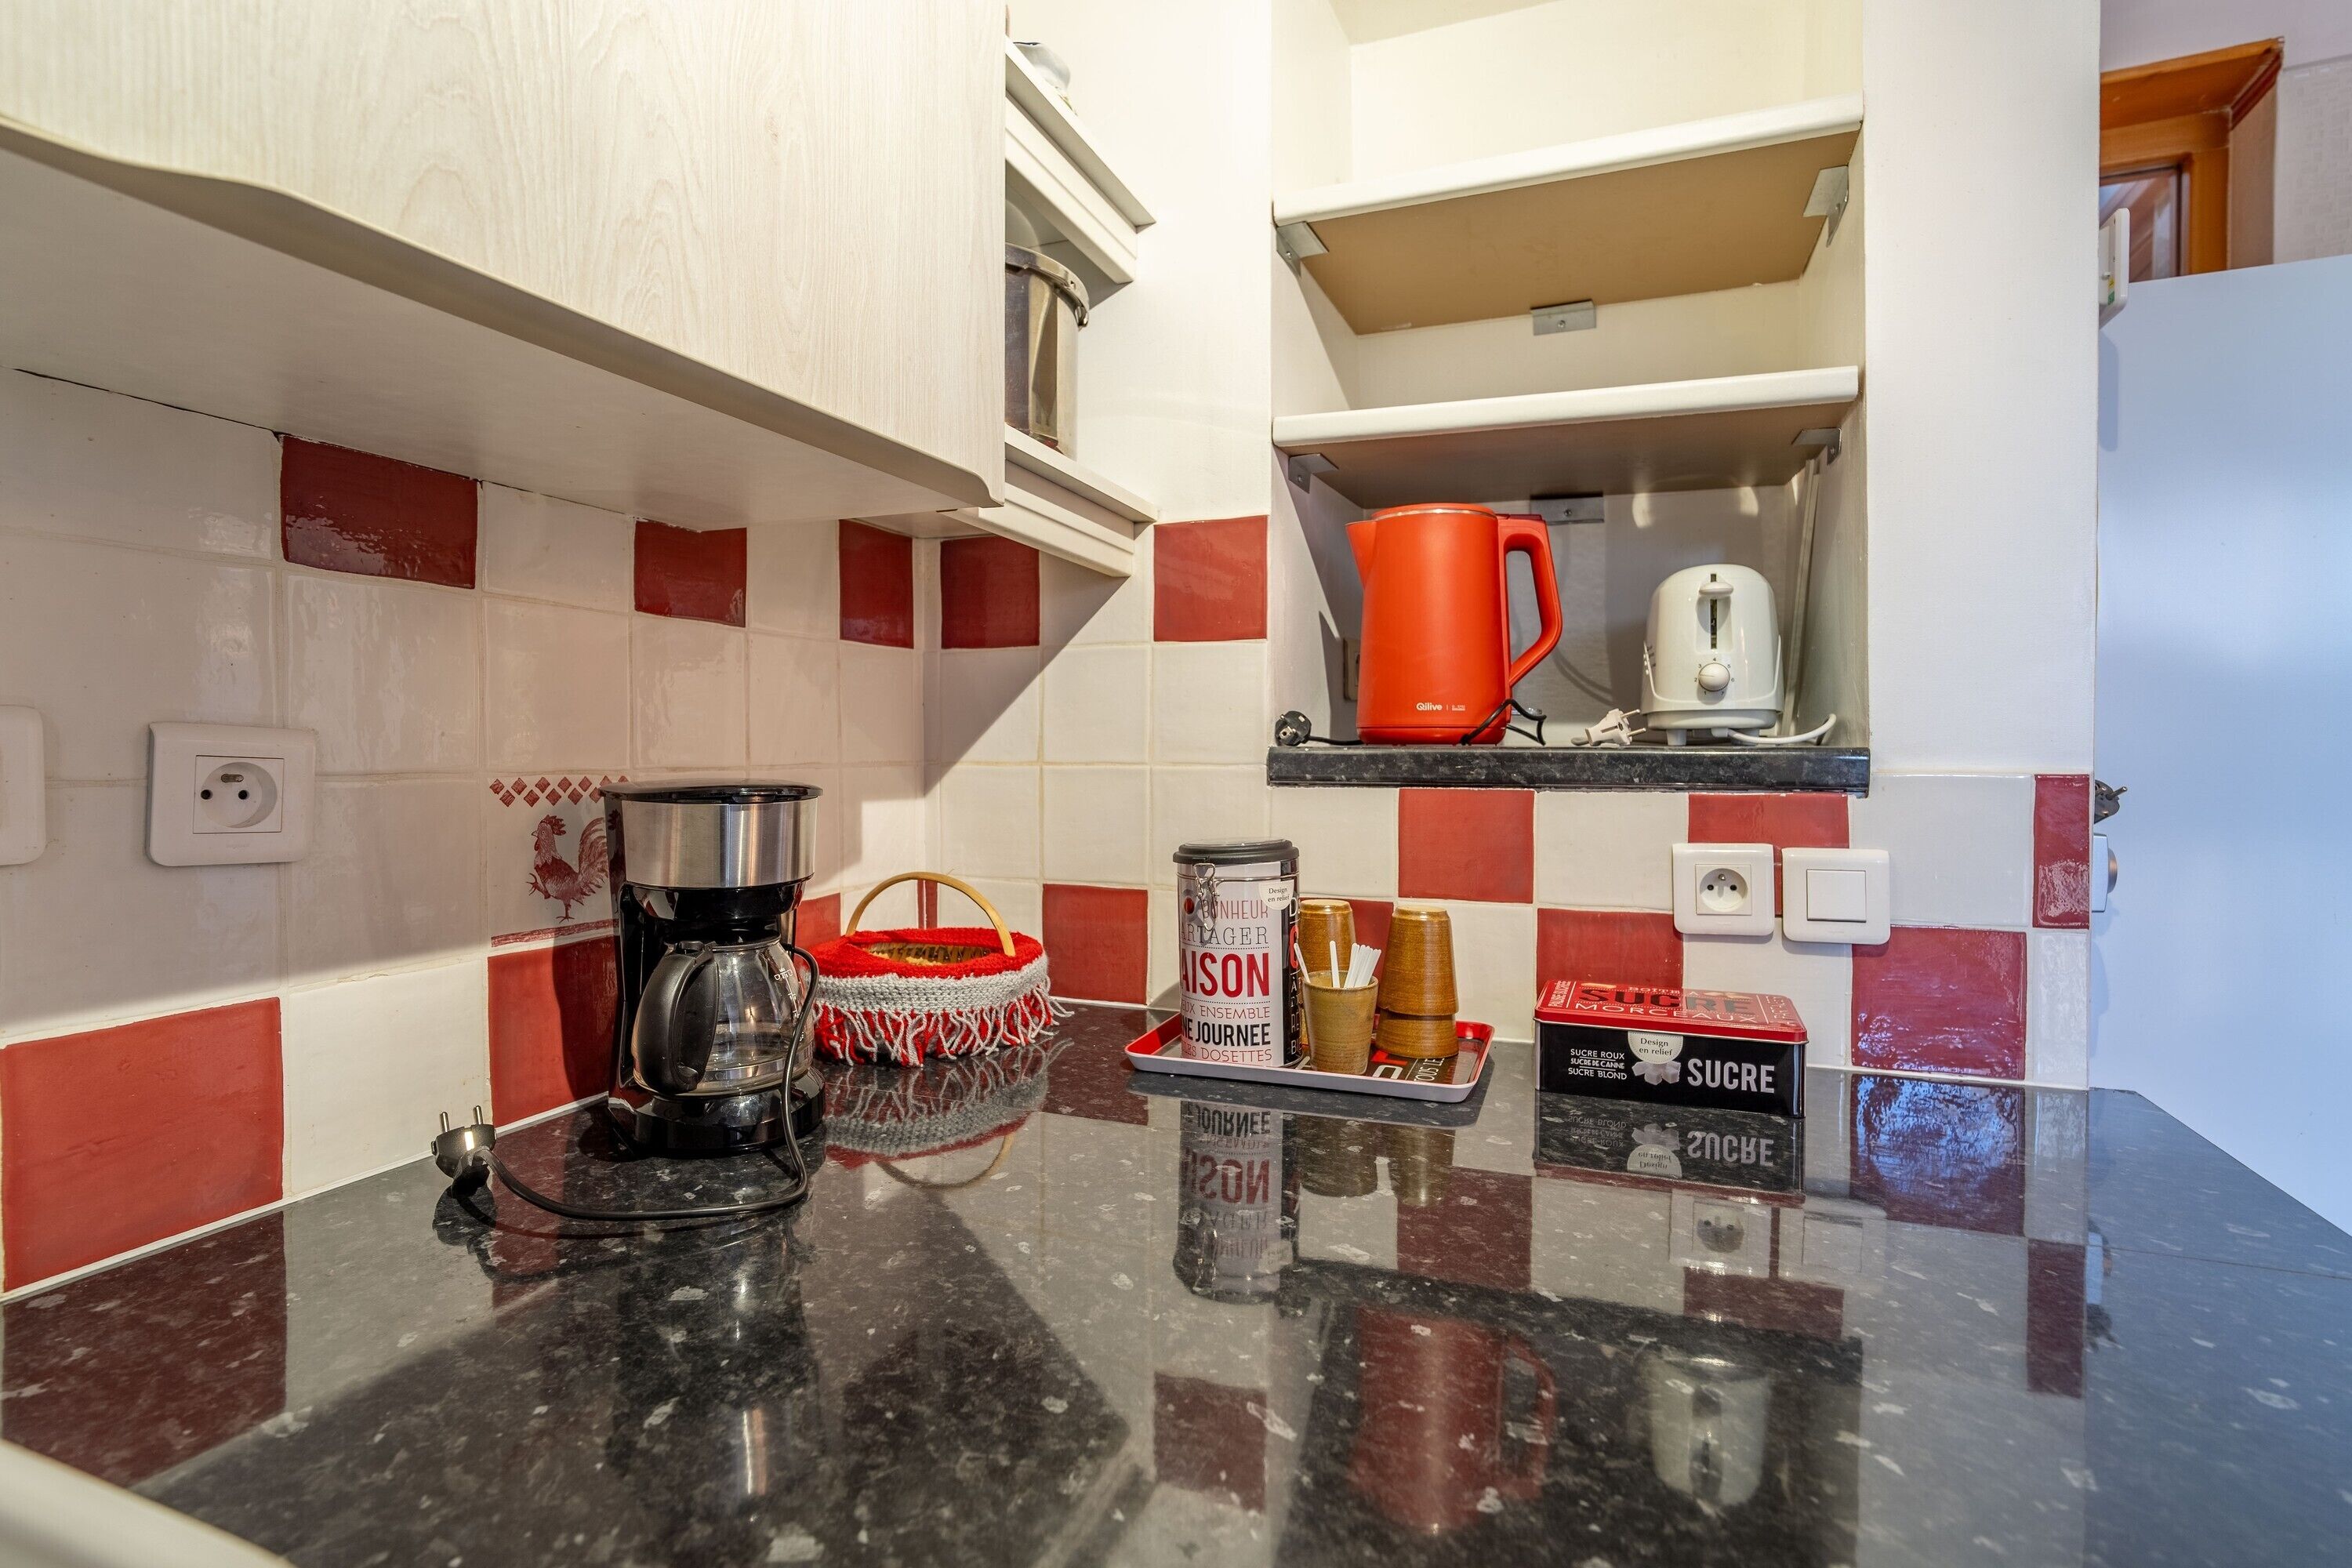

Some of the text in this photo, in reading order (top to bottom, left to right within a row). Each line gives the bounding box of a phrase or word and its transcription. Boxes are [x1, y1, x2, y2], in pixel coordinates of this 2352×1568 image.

[1416, 702, 1443, 711] Qilive
[1181, 923, 1269, 946] ARTAGER
[1181, 948, 1270, 998] AISON
[1578, 989, 1753, 1016] SUCRE
[1200, 1005, 1270, 1019] ENSEMBLE
[1575, 1003, 1757, 1023] MORCEAUX
[1182, 1015, 1193, 1040] NE
[1196, 1021, 1271, 1047] JOURNEE
[1640, 1037, 1668, 1047] Design
[1200, 1047, 1272, 1062] DOSETTES
[1570, 1049, 1625, 1060] SUCRE ROUX
[1570, 1058, 1592, 1066] SUCRE
[1600, 1061, 1625, 1069] CANNE
[1568, 1067, 1627, 1080] SUCRE BLOND
[1687, 1058, 1775, 1094] SUCRE
